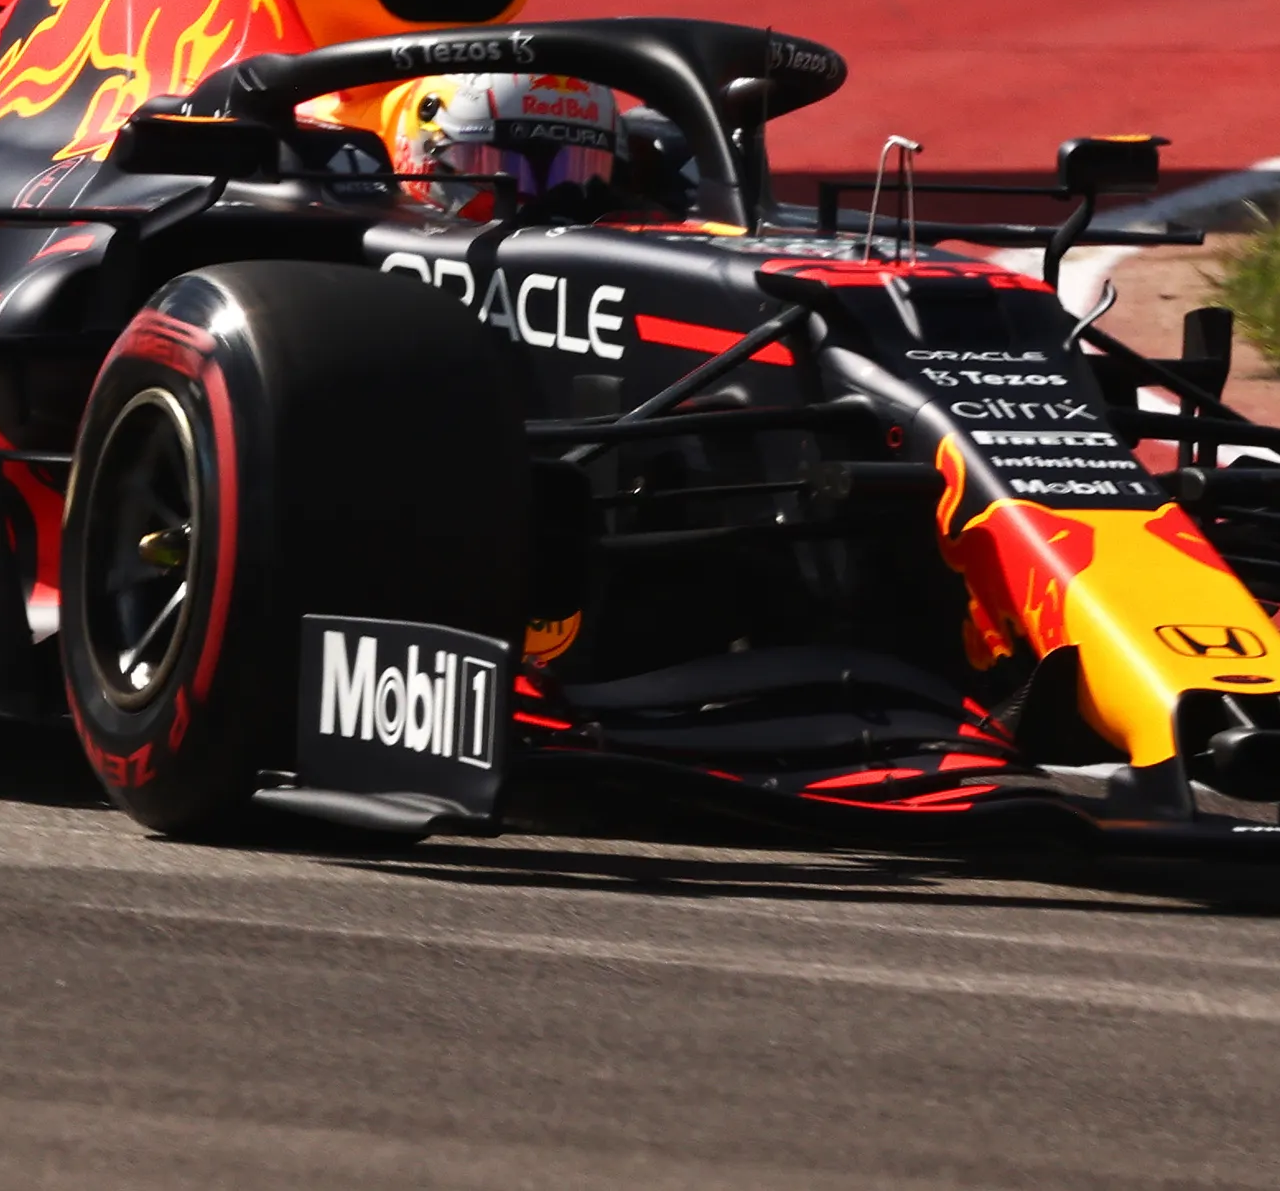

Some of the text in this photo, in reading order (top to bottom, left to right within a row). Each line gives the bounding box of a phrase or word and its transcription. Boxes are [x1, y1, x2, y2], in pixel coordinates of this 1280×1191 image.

[421, 38, 502, 65] Tezos
[522, 94, 599, 122] Red Bull
[529, 124, 609, 146] ACURA
[905, 349, 1048, 362] ORACLE
[958, 370, 1069, 386] Tezos
[991, 456, 1138, 469] infinitum
[1009, 478, 1120, 495] Mobil
[320, 630, 458, 758] Mobil
